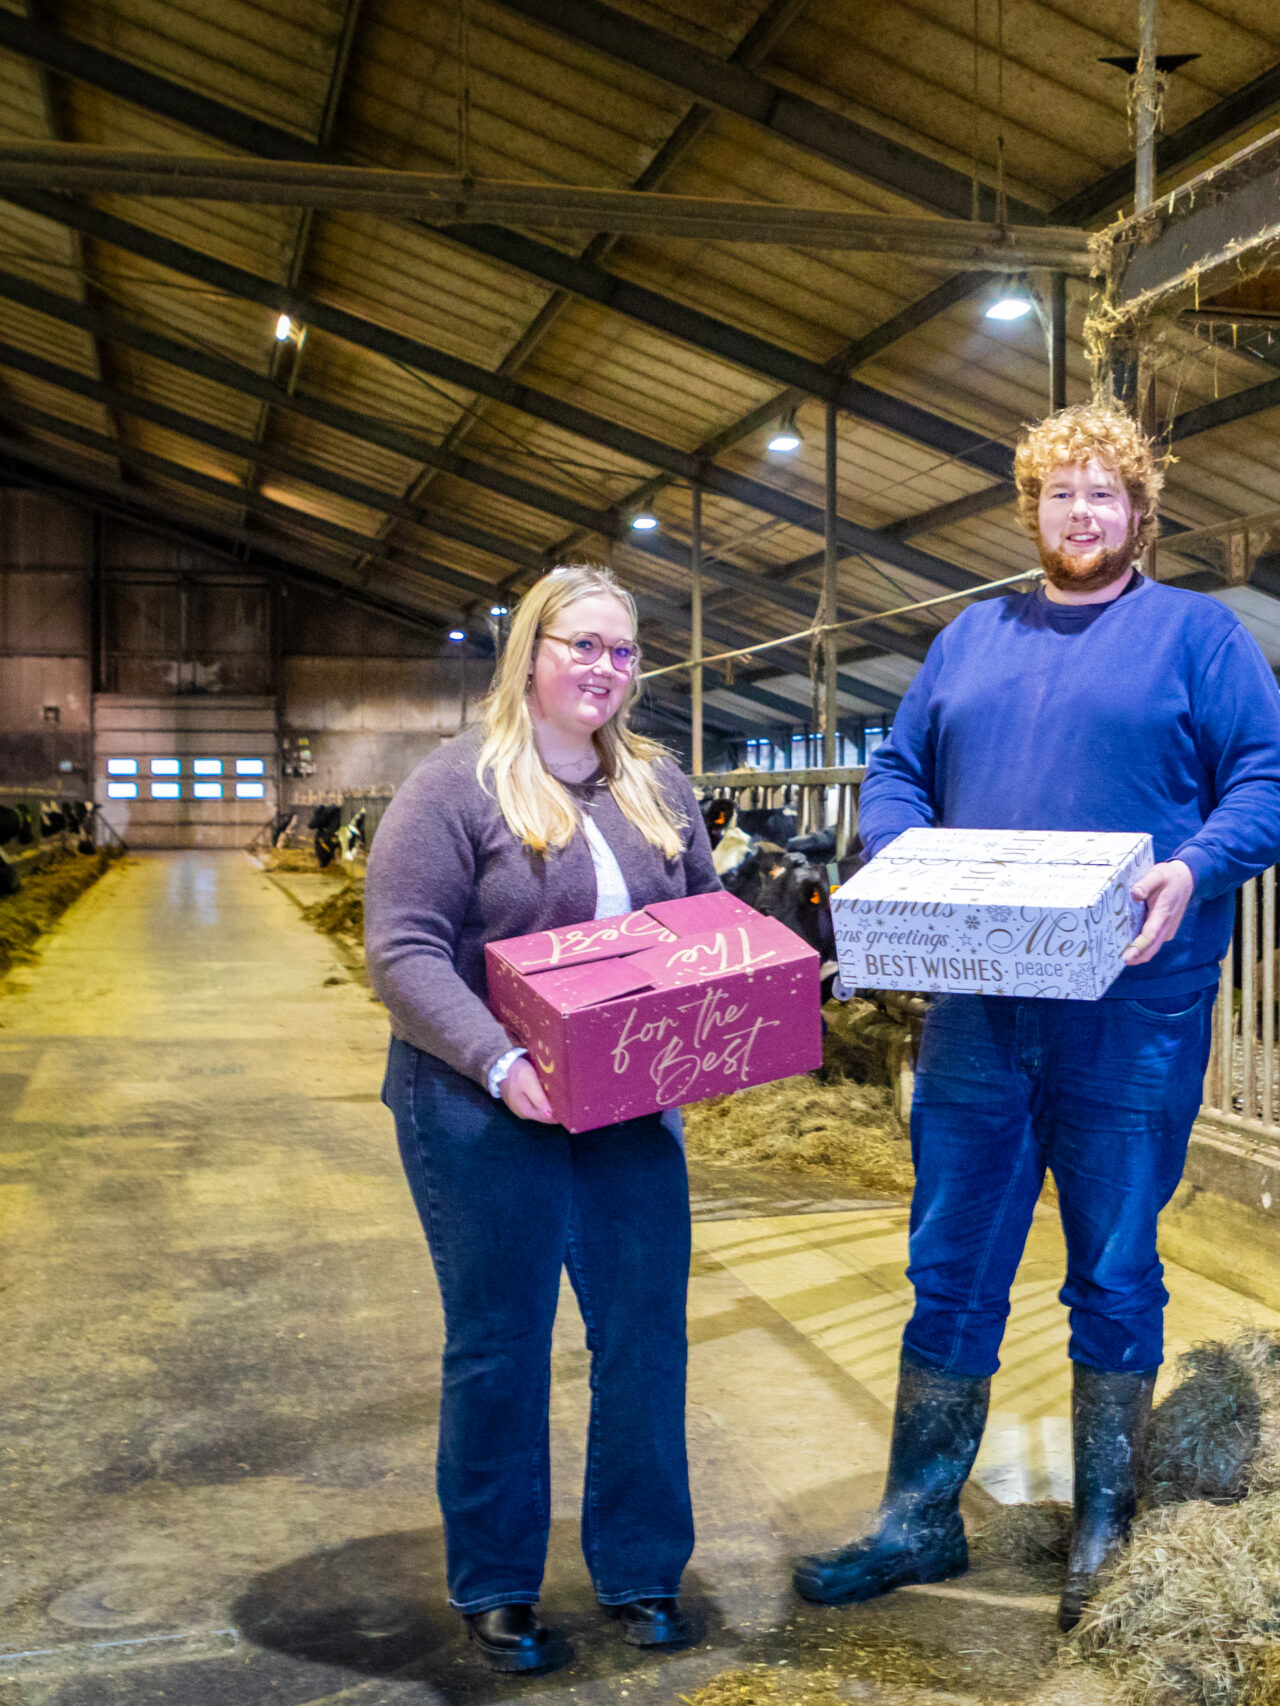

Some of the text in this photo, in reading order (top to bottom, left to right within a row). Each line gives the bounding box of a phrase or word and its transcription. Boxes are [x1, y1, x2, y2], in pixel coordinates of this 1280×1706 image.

[521, 908, 679, 966] Best
[666, 927, 776, 976] The
[862, 929, 949, 954] greetings
[865, 953, 1004, 982] BEST WISHES
[1015, 961, 1063, 979] peace
[610, 1008, 679, 1075] for
[676, 986, 748, 1048] the
[650, 1017, 781, 1105] Best
